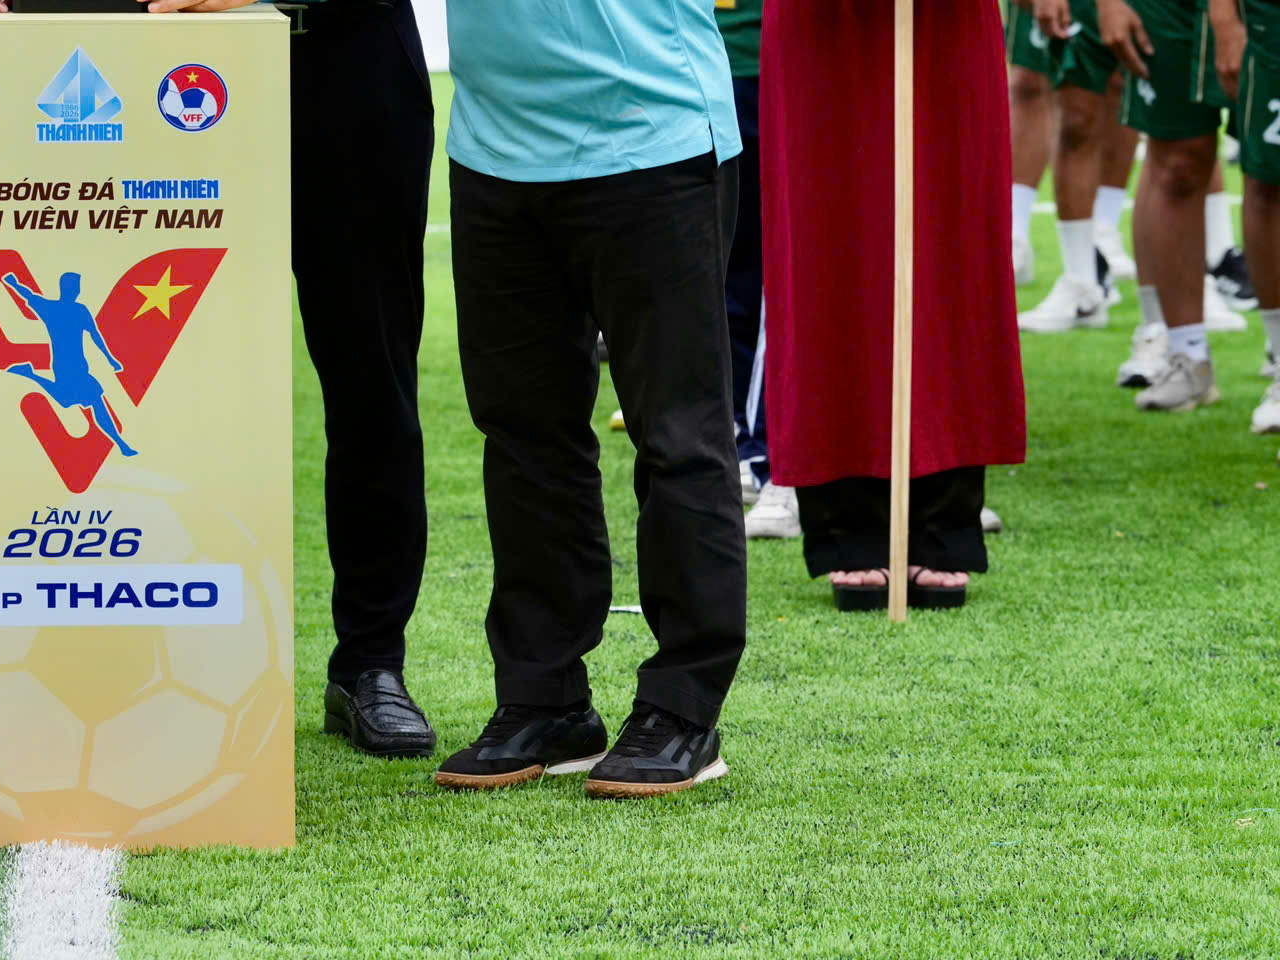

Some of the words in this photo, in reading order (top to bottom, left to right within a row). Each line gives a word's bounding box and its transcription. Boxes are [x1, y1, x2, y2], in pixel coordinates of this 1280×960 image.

[60, 110, 80, 118] 2026
[183, 113, 203, 123] VFF
[78, 176, 115, 201] ĐÁ
[122, 180, 179, 199] THANH
[13, 205, 79, 230] VIÊN
[88, 205, 148, 233] VIỆT
[154, 209, 224, 230] NAM
[31, 506, 81, 525] LẦN
[88, 510, 113, 525] IV
[3, 527, 142, 558] 2026
[36, 581, 219, 608] THACO
